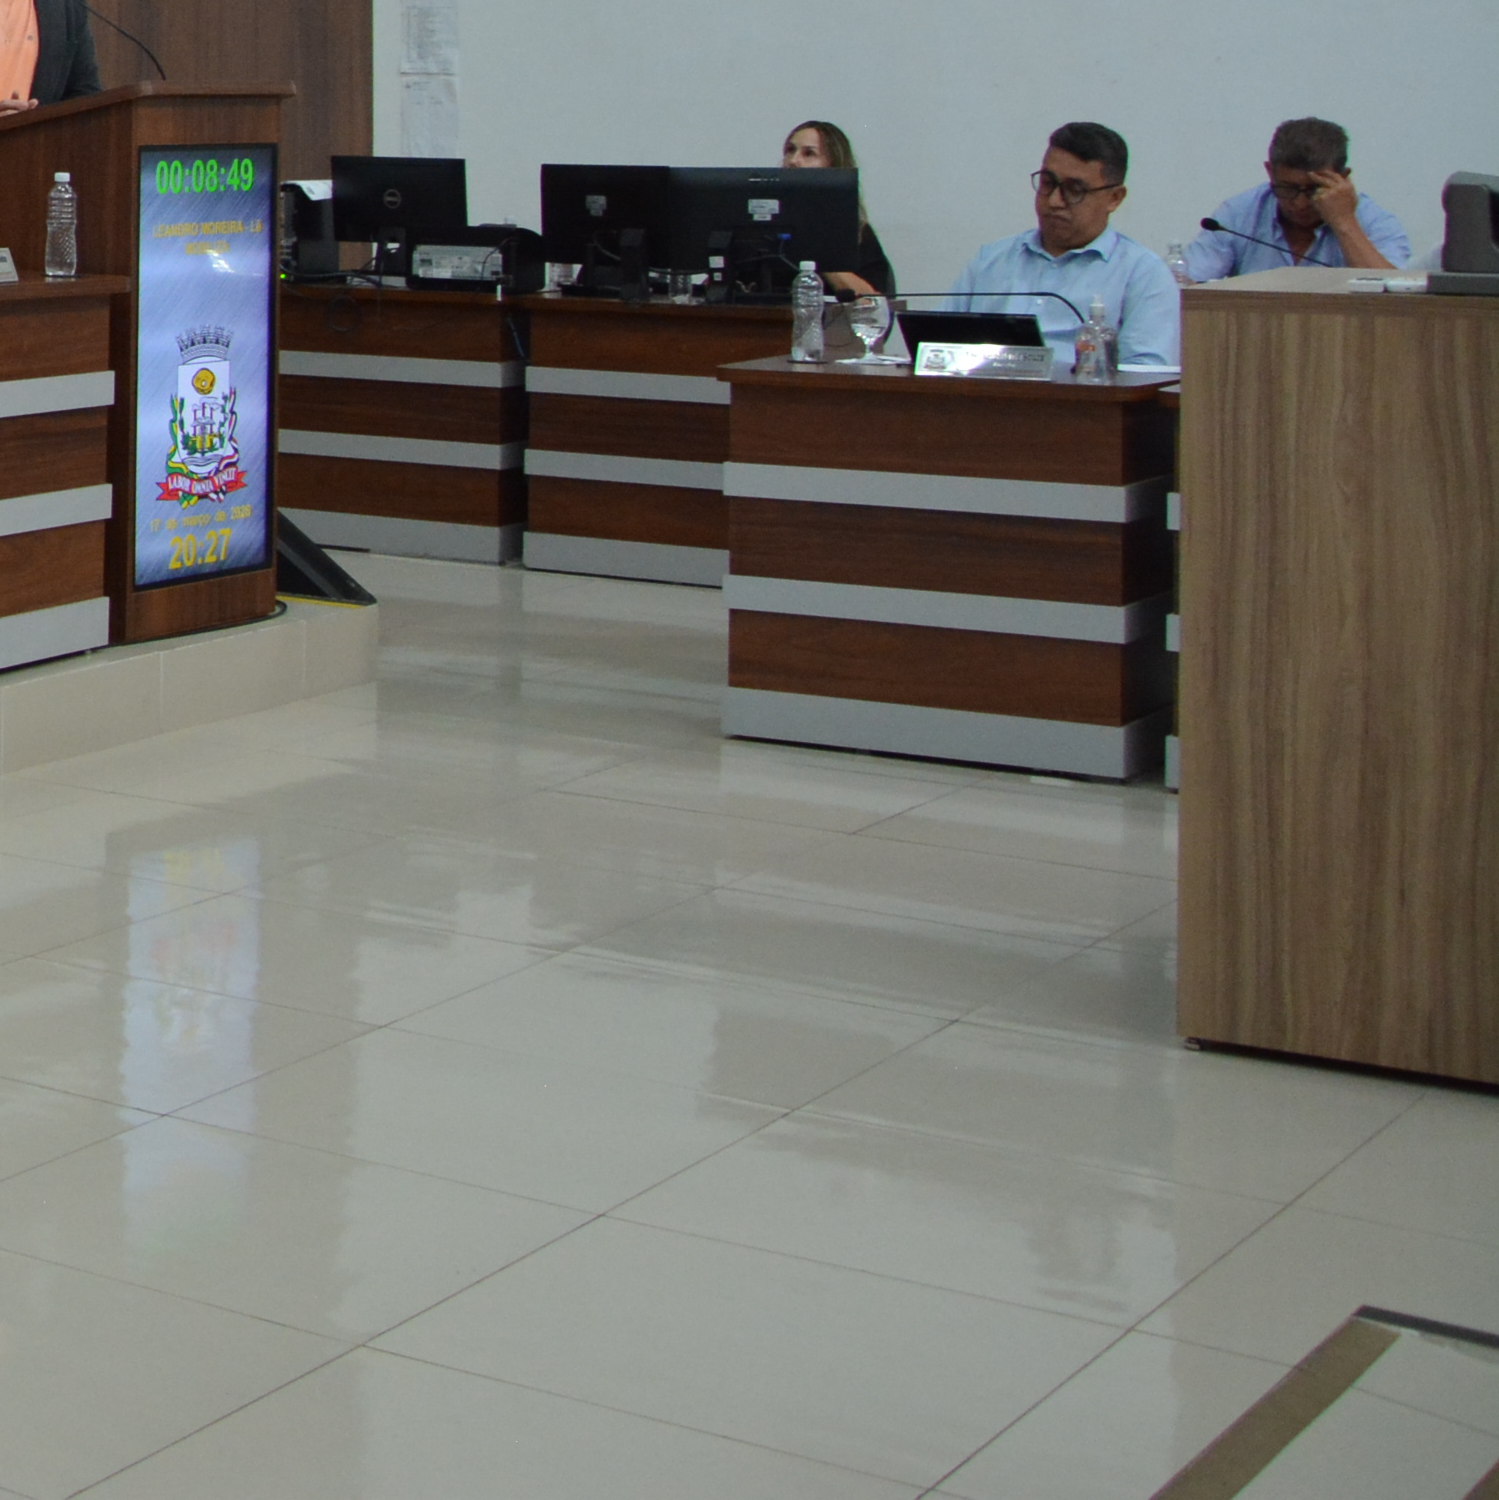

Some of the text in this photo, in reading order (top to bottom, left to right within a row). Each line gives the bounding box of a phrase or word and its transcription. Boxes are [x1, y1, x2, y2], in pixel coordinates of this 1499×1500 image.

[156, 159, 254, 194] 00:08:49
[167, 474, 191, 493] LABOR
[169, 527, 232, 570] 20:27
